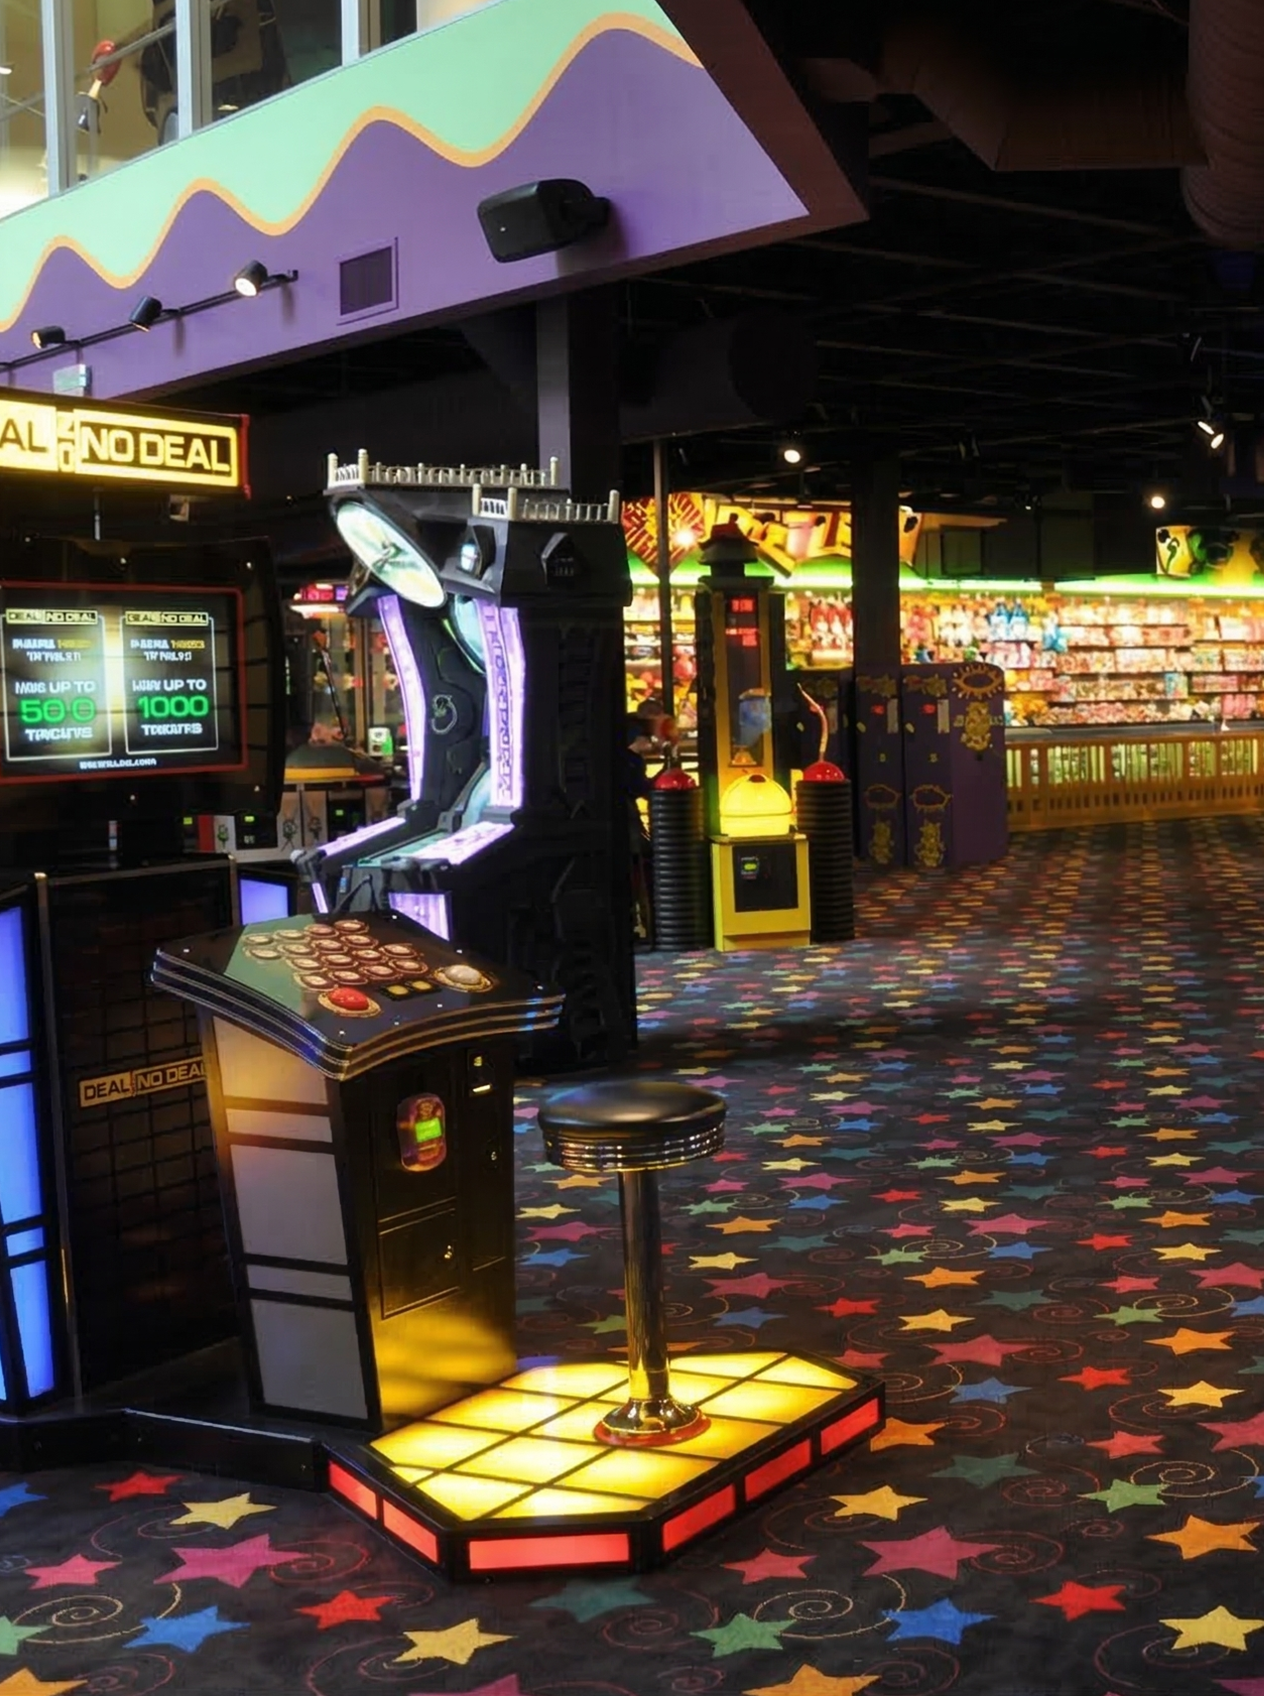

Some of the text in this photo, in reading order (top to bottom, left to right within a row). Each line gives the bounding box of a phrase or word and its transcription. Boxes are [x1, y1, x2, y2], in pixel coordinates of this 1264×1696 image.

[81, 427, 135, 463] NO
[139, 432, 231, 473] DEAL
[163, 680, 184, 692] UP
[187, 678, 207, 691] TO
[138, 695, 209, 718] 1000
[83, 1078, 130, 1101] DEAL
[138, 1071, 162, 1089] NO
